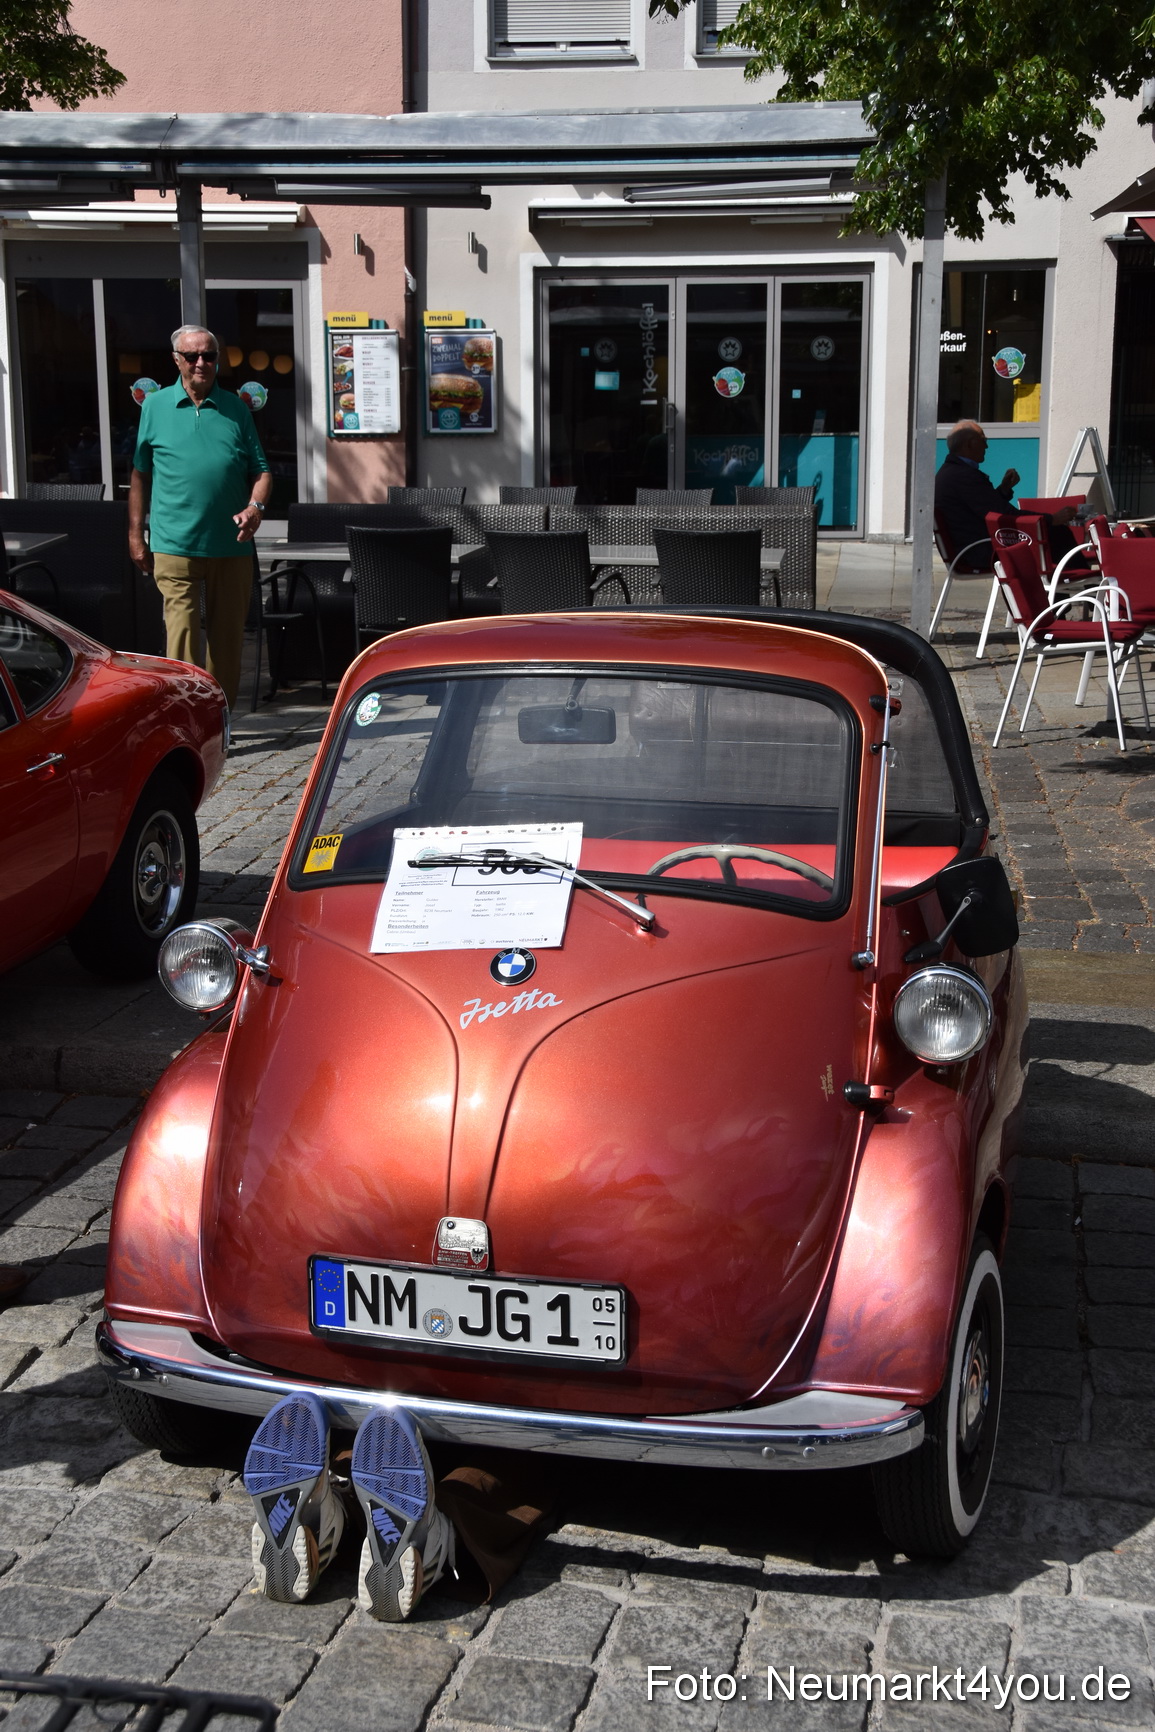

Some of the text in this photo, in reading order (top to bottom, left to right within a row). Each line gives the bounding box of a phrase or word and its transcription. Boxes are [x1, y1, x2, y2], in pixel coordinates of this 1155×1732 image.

[639, 303, 658, 395] Kochlöffel
[312, 836, 341, 850] ADAC
[498, 947, 533, 960] BMW
[460, 988, 564, 1030] Isetta
[324, 1300, 336, 1316] D
[347, 1270, 417, 1330] NM
[458, 1284, 531, 1343] JG
[546, 1292, 579, 1347] 1
[592, 1297, 616, 1313] 05
[594, 1335, 616, 1351] 10
[268, 1493, 296, 1538] NIKE
[371, 1507, 402, 1545] NIKE
